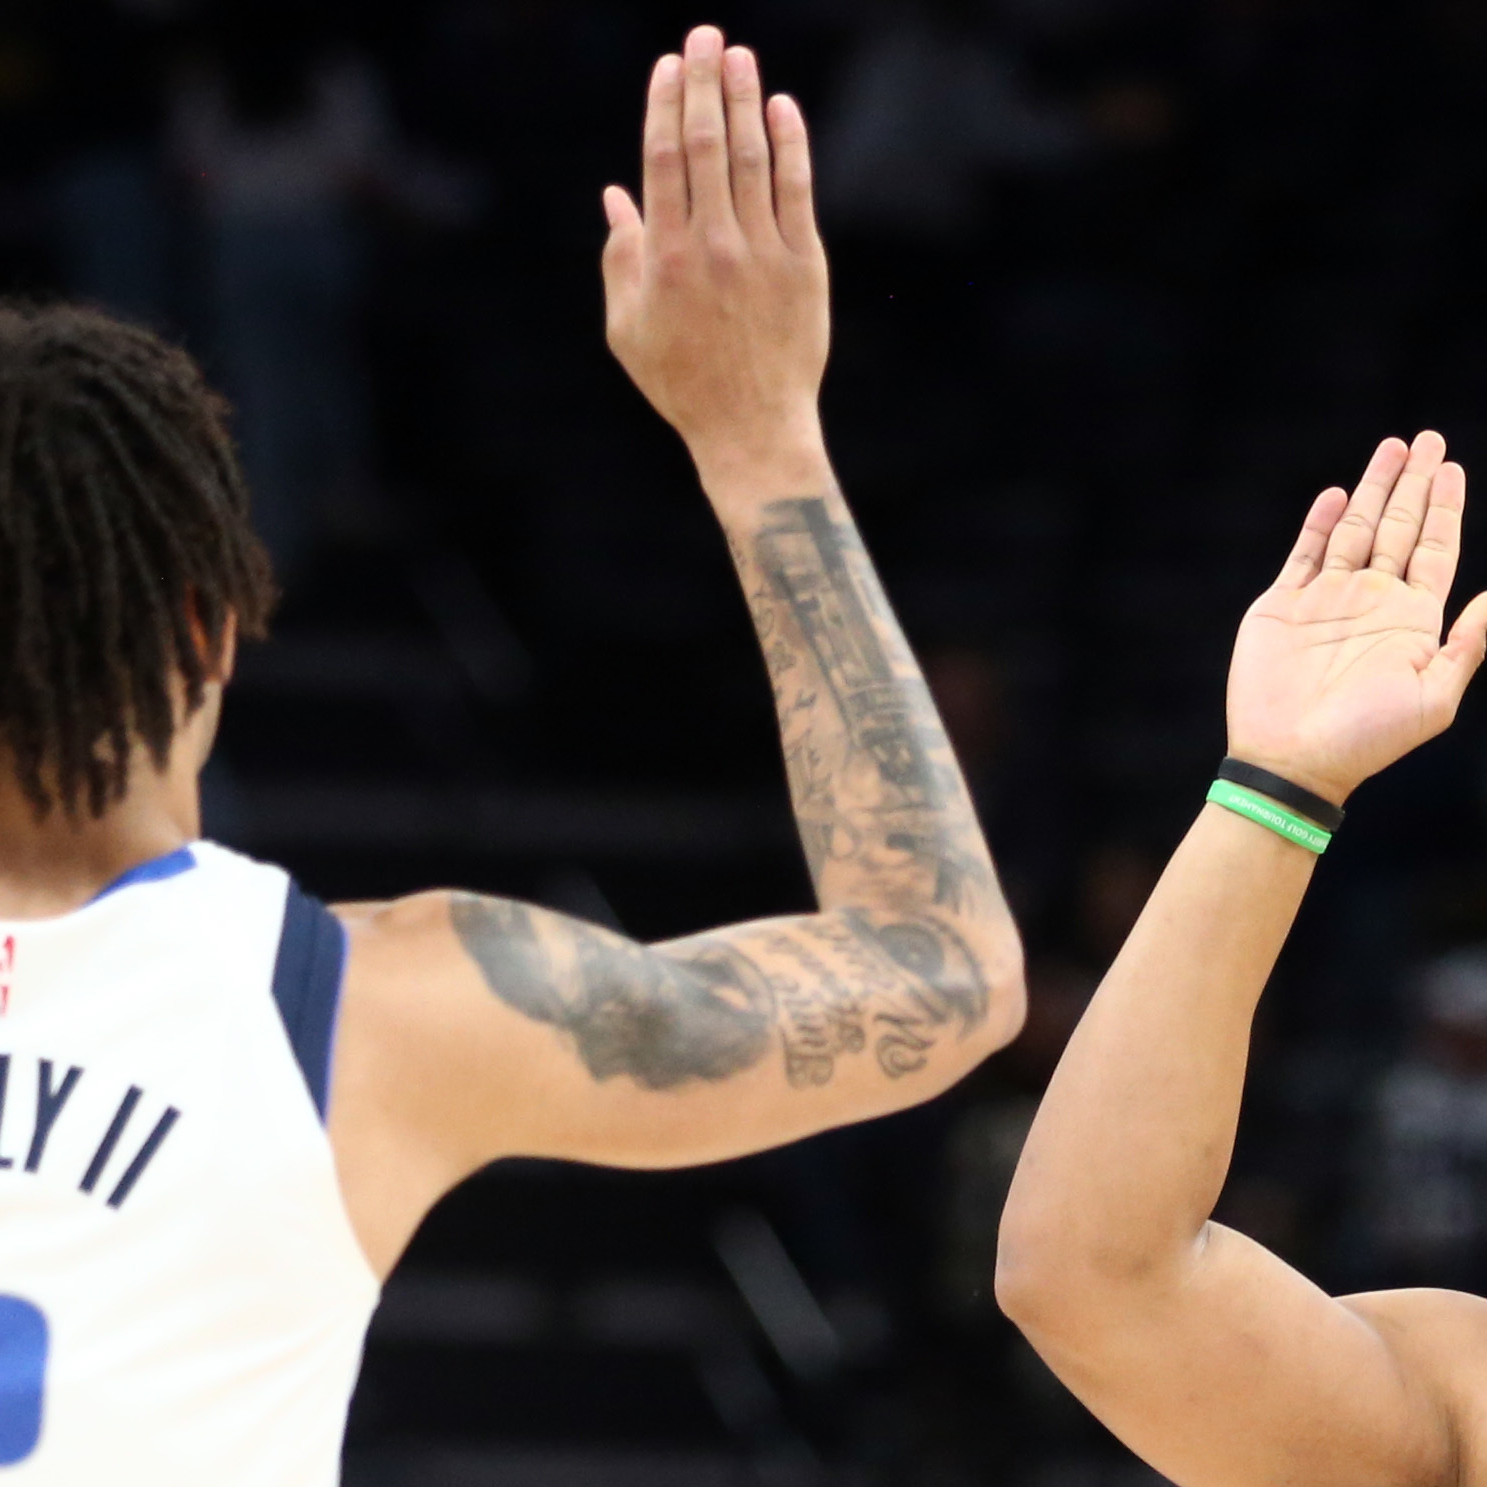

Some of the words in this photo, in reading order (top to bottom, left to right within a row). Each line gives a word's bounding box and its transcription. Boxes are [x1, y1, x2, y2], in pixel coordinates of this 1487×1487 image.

[1227, 793, 1286, 829] TOURNAMENT
[1284, 821, 1309, 841] GOLF
[78, 1084, 181, 1209] II
